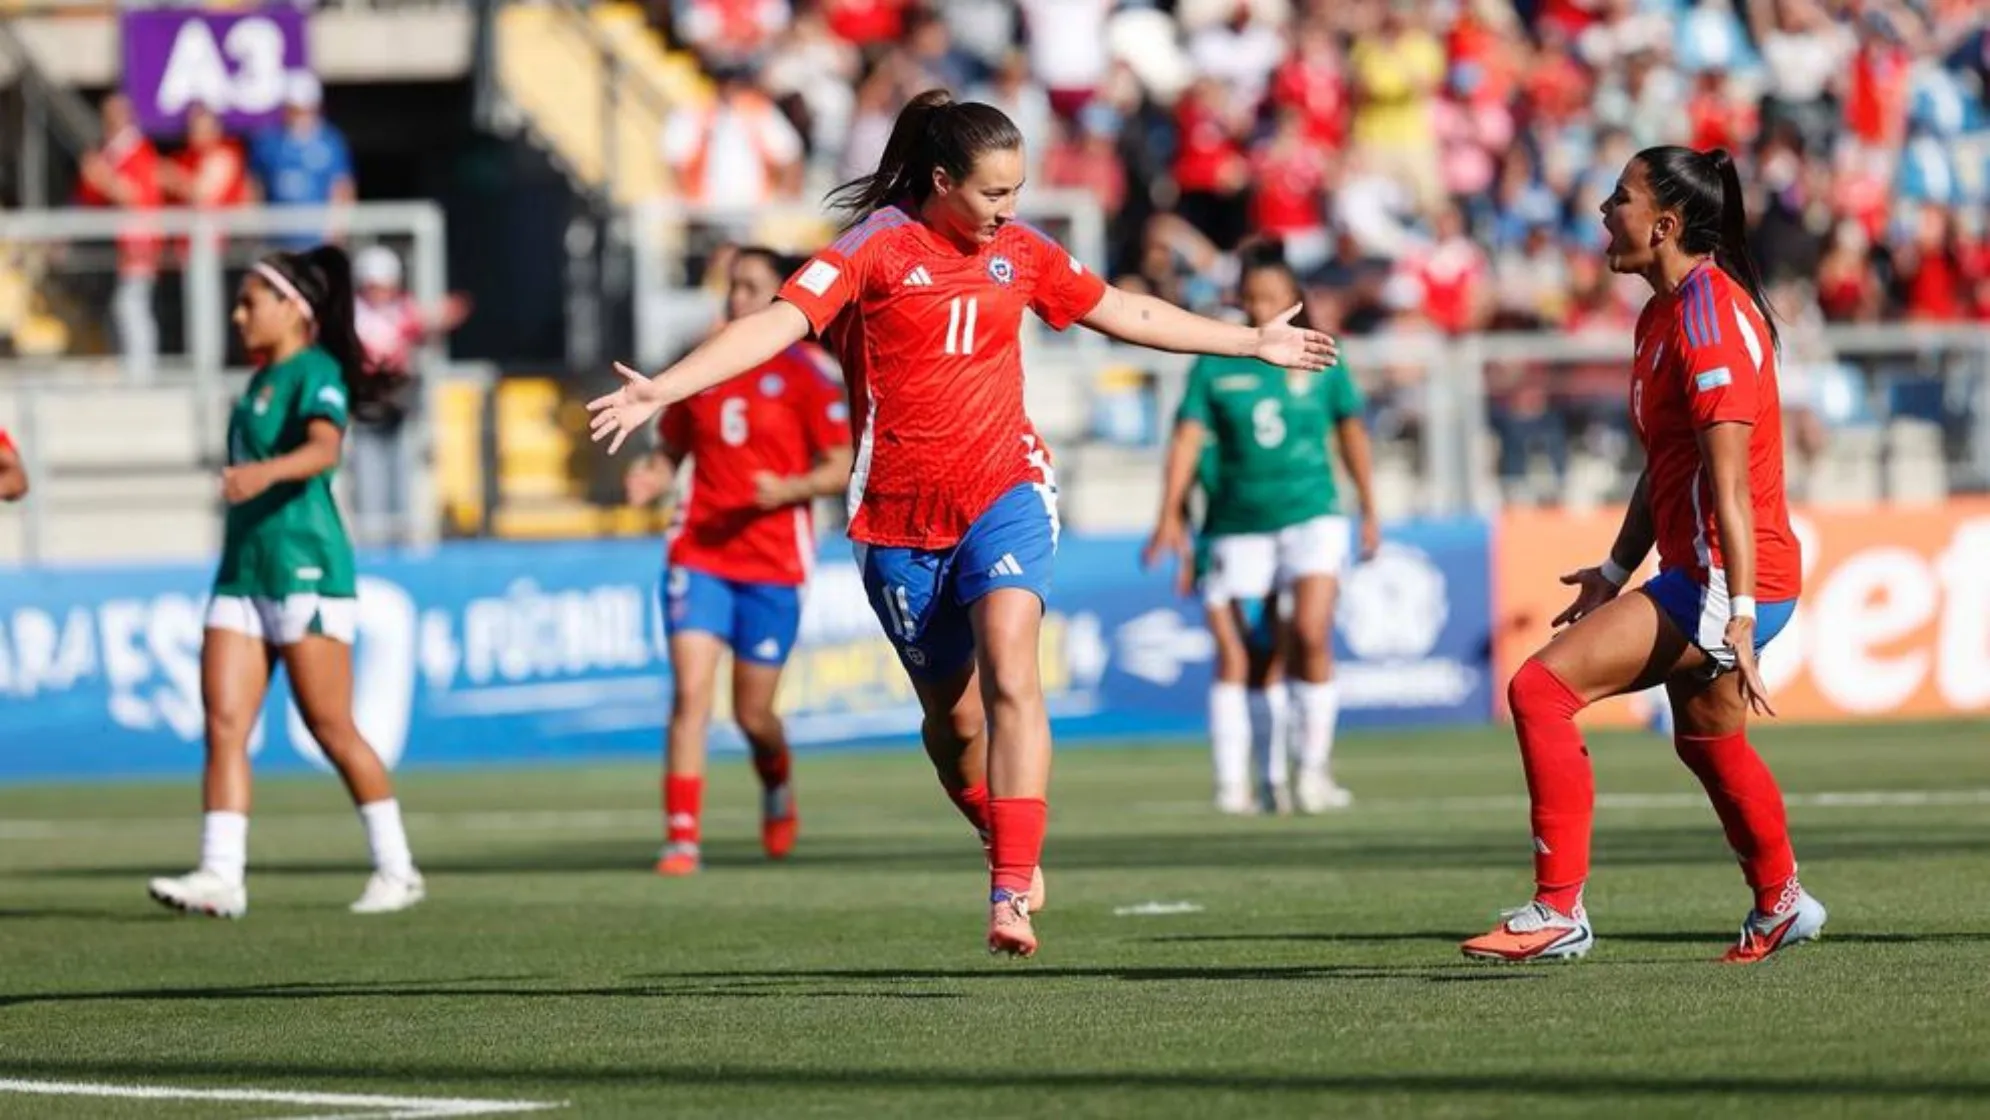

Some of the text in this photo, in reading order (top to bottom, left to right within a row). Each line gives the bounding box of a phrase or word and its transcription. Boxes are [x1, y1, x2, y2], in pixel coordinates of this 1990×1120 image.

[156, 18, 286, 116] A3
[946, 296, 978, 355] 11
[720, 397, 750, 446] 6
[1252, 397, 1287, 449] 5
